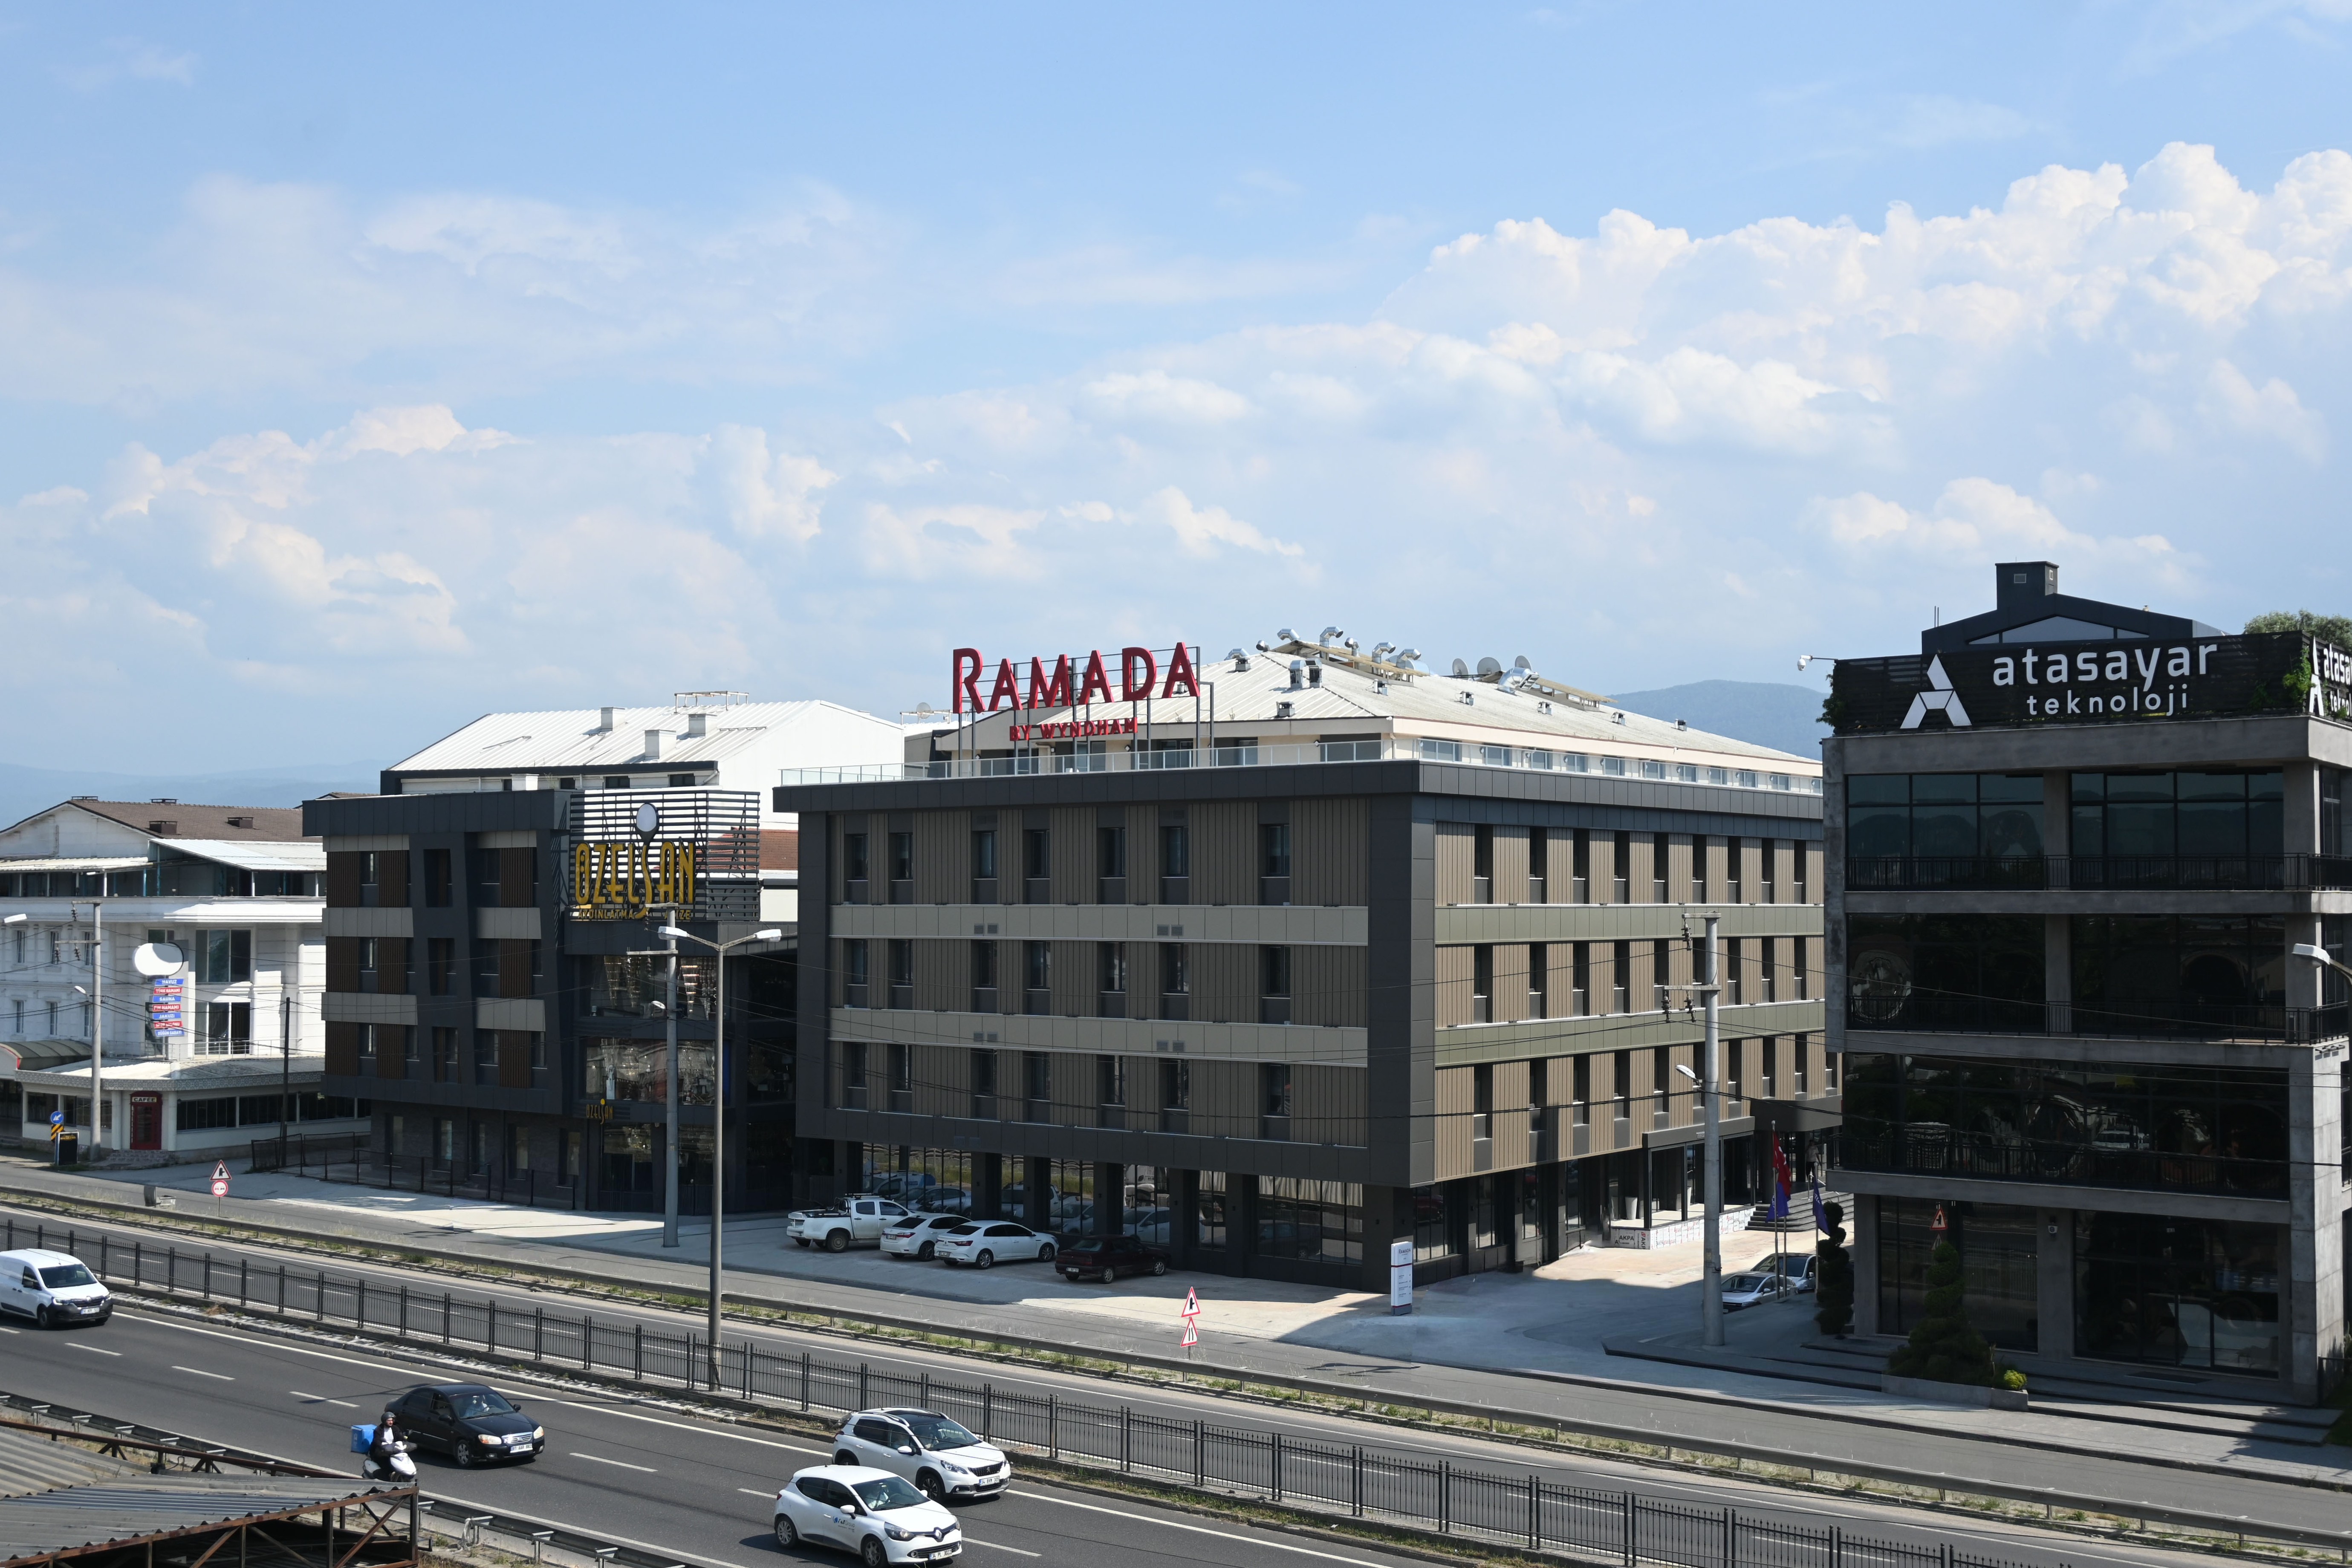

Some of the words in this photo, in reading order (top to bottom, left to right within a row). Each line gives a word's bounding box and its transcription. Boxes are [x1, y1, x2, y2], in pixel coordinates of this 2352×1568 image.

[953, 642, 1200, 713] RAMADA
[1993, 644, 2217, 691] atasayar
[2027, 684, 2187, 716] teknoloji
[1010, 725, 1032, 741] BY
[1040, 717, 1138, 738] WYNDHAM
[578, 909, 634, 919] AYDINLATMA
